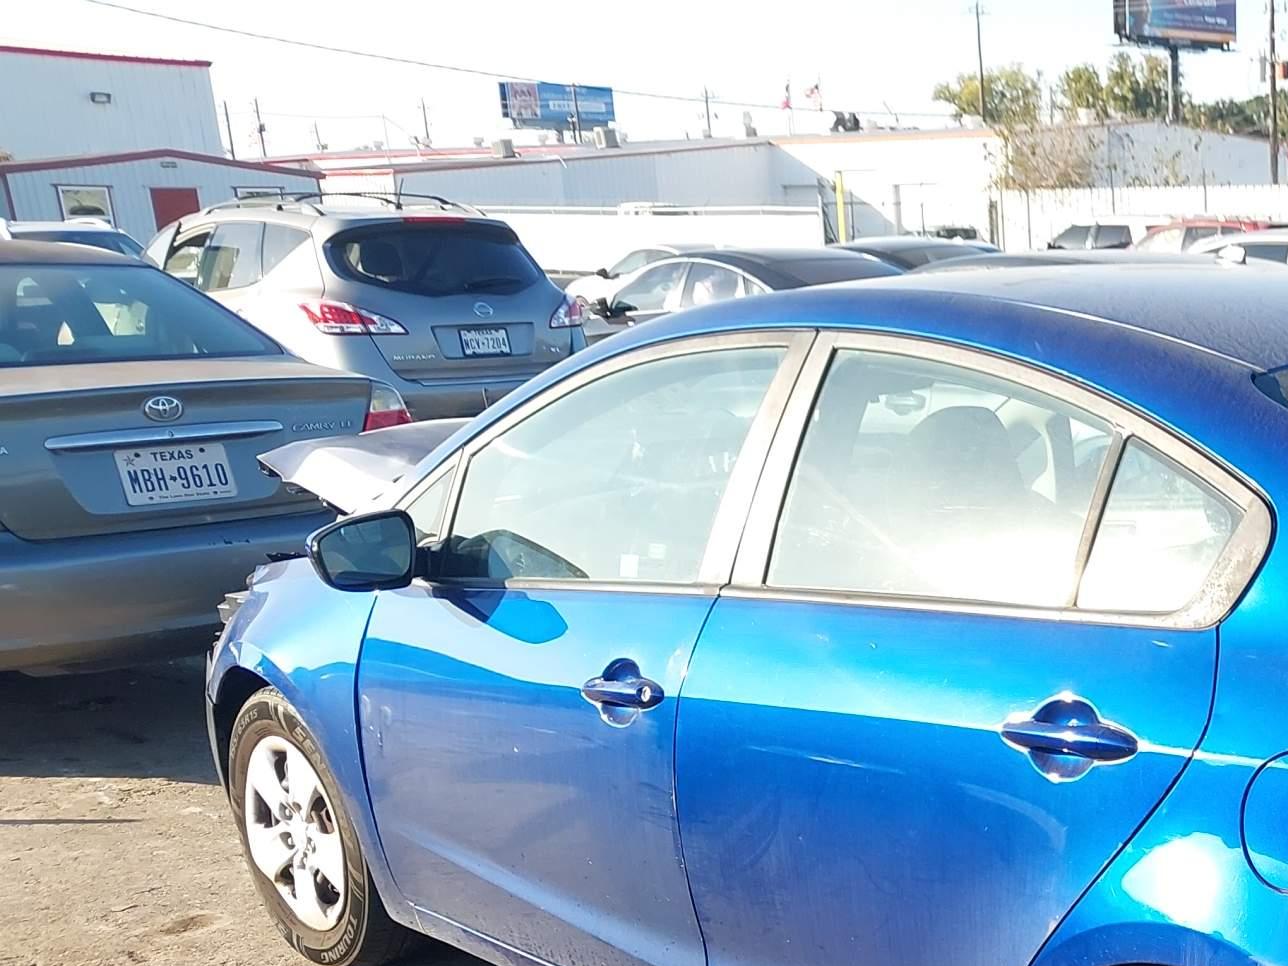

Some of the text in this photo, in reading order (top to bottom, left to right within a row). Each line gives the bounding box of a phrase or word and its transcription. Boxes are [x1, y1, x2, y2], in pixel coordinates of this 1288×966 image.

[292, 422, 336, 432] CAMRY
[150, 449, 194, 463] TEXAS
[320, 913, 358, 963] TOURING
